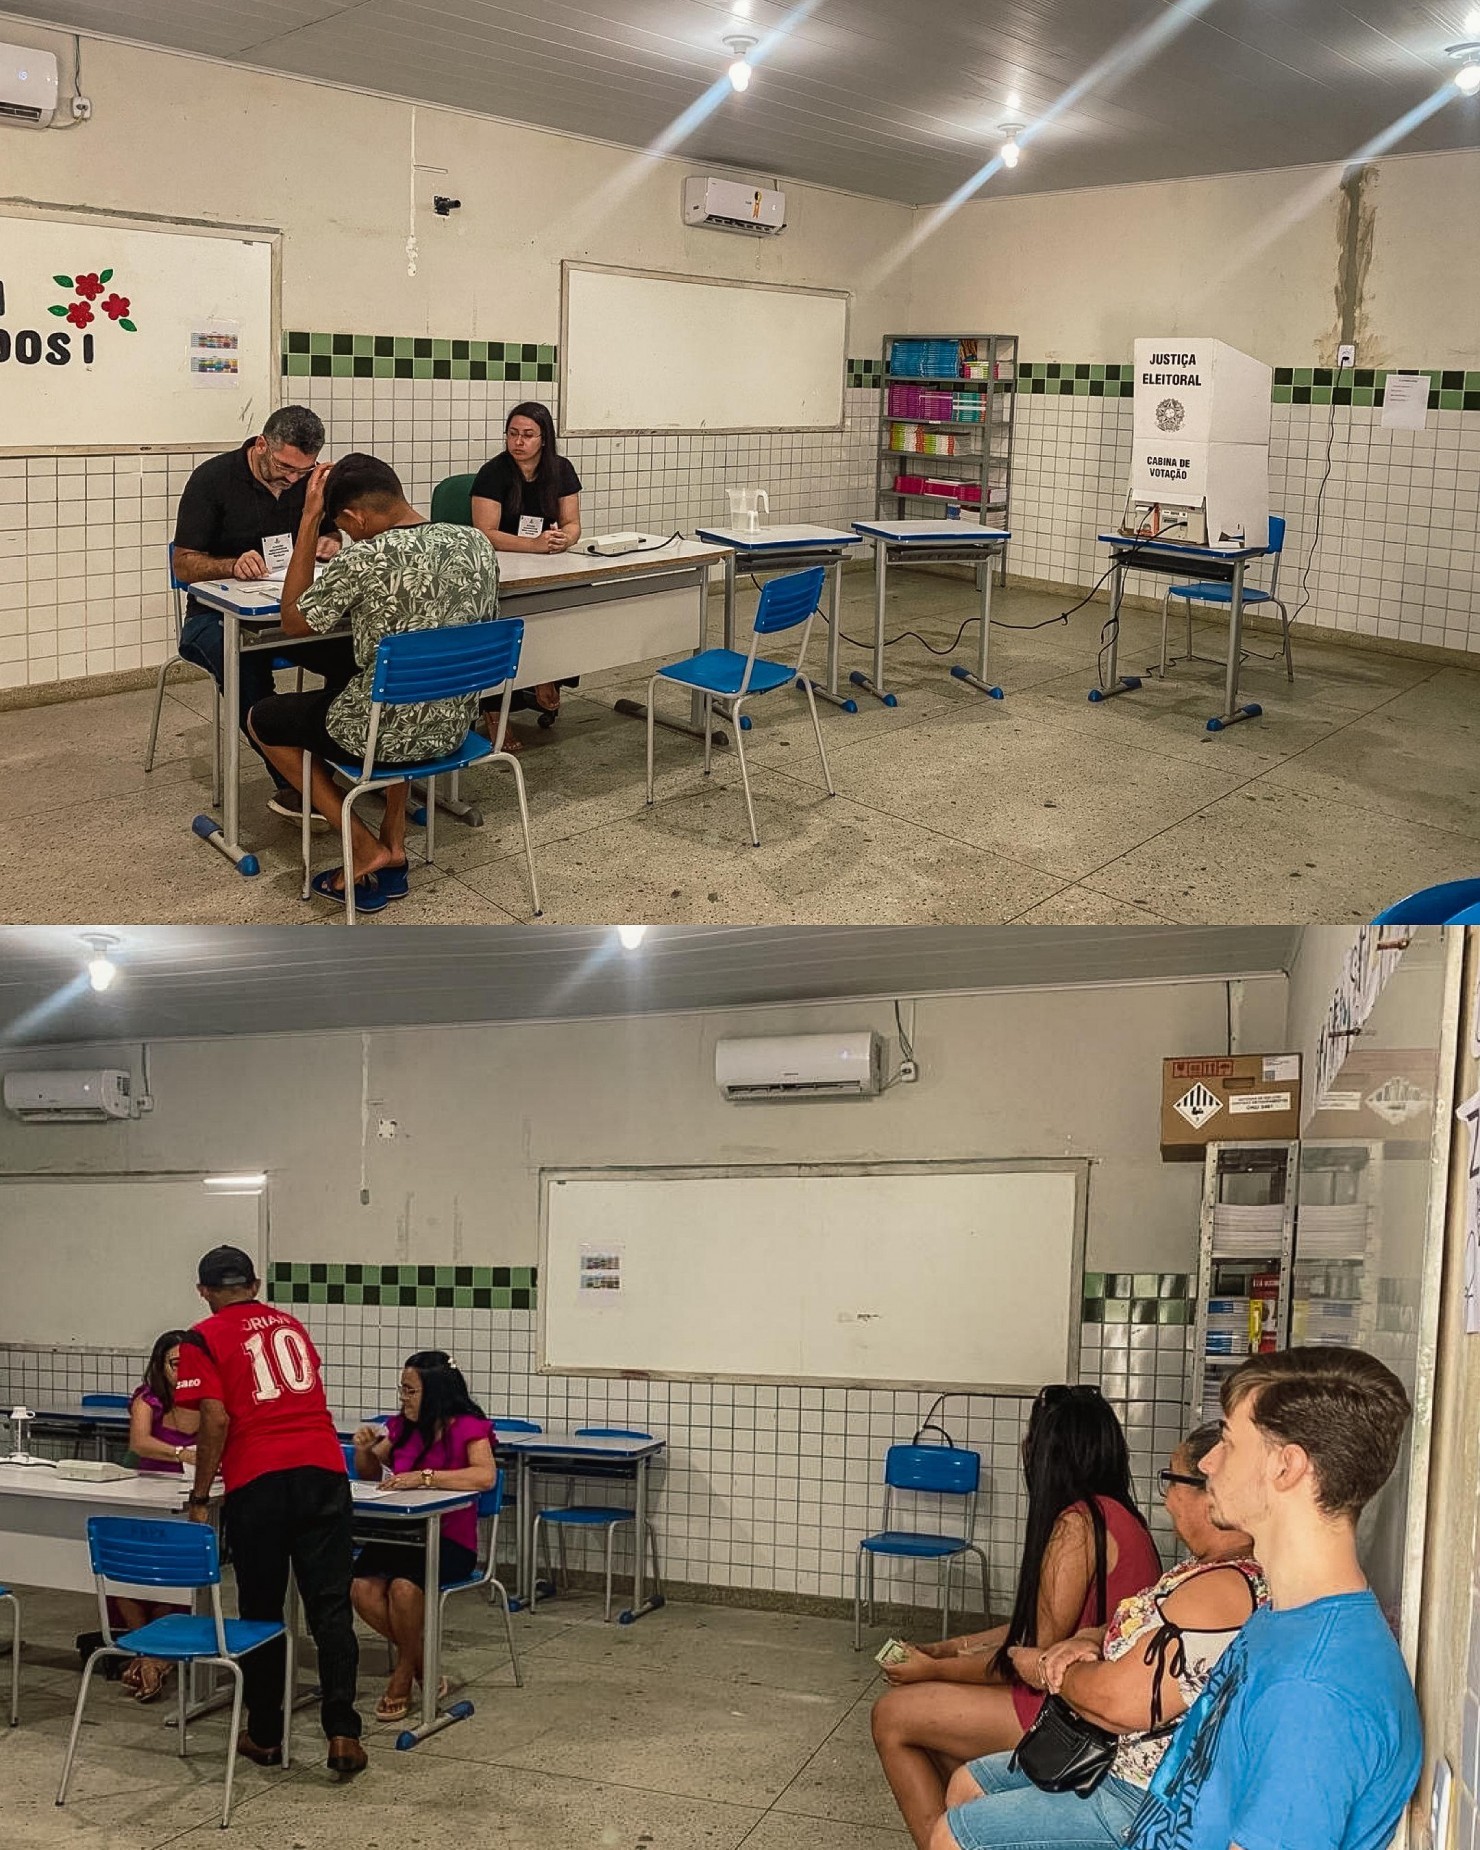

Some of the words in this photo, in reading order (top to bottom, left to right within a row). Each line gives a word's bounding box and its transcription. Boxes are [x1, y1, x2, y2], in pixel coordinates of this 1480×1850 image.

[1149, 353, 1197, 368] JUSTIÇA
[1142, 373, 1202, 386] ELEITORAL
[1147, 456, 1177, 467] CABINA
[1179, 458, 1191, 468] DE
[1149, 467, 1187, 480] VOTAÇÃO
[241, 1325, 317, 1405] 10
